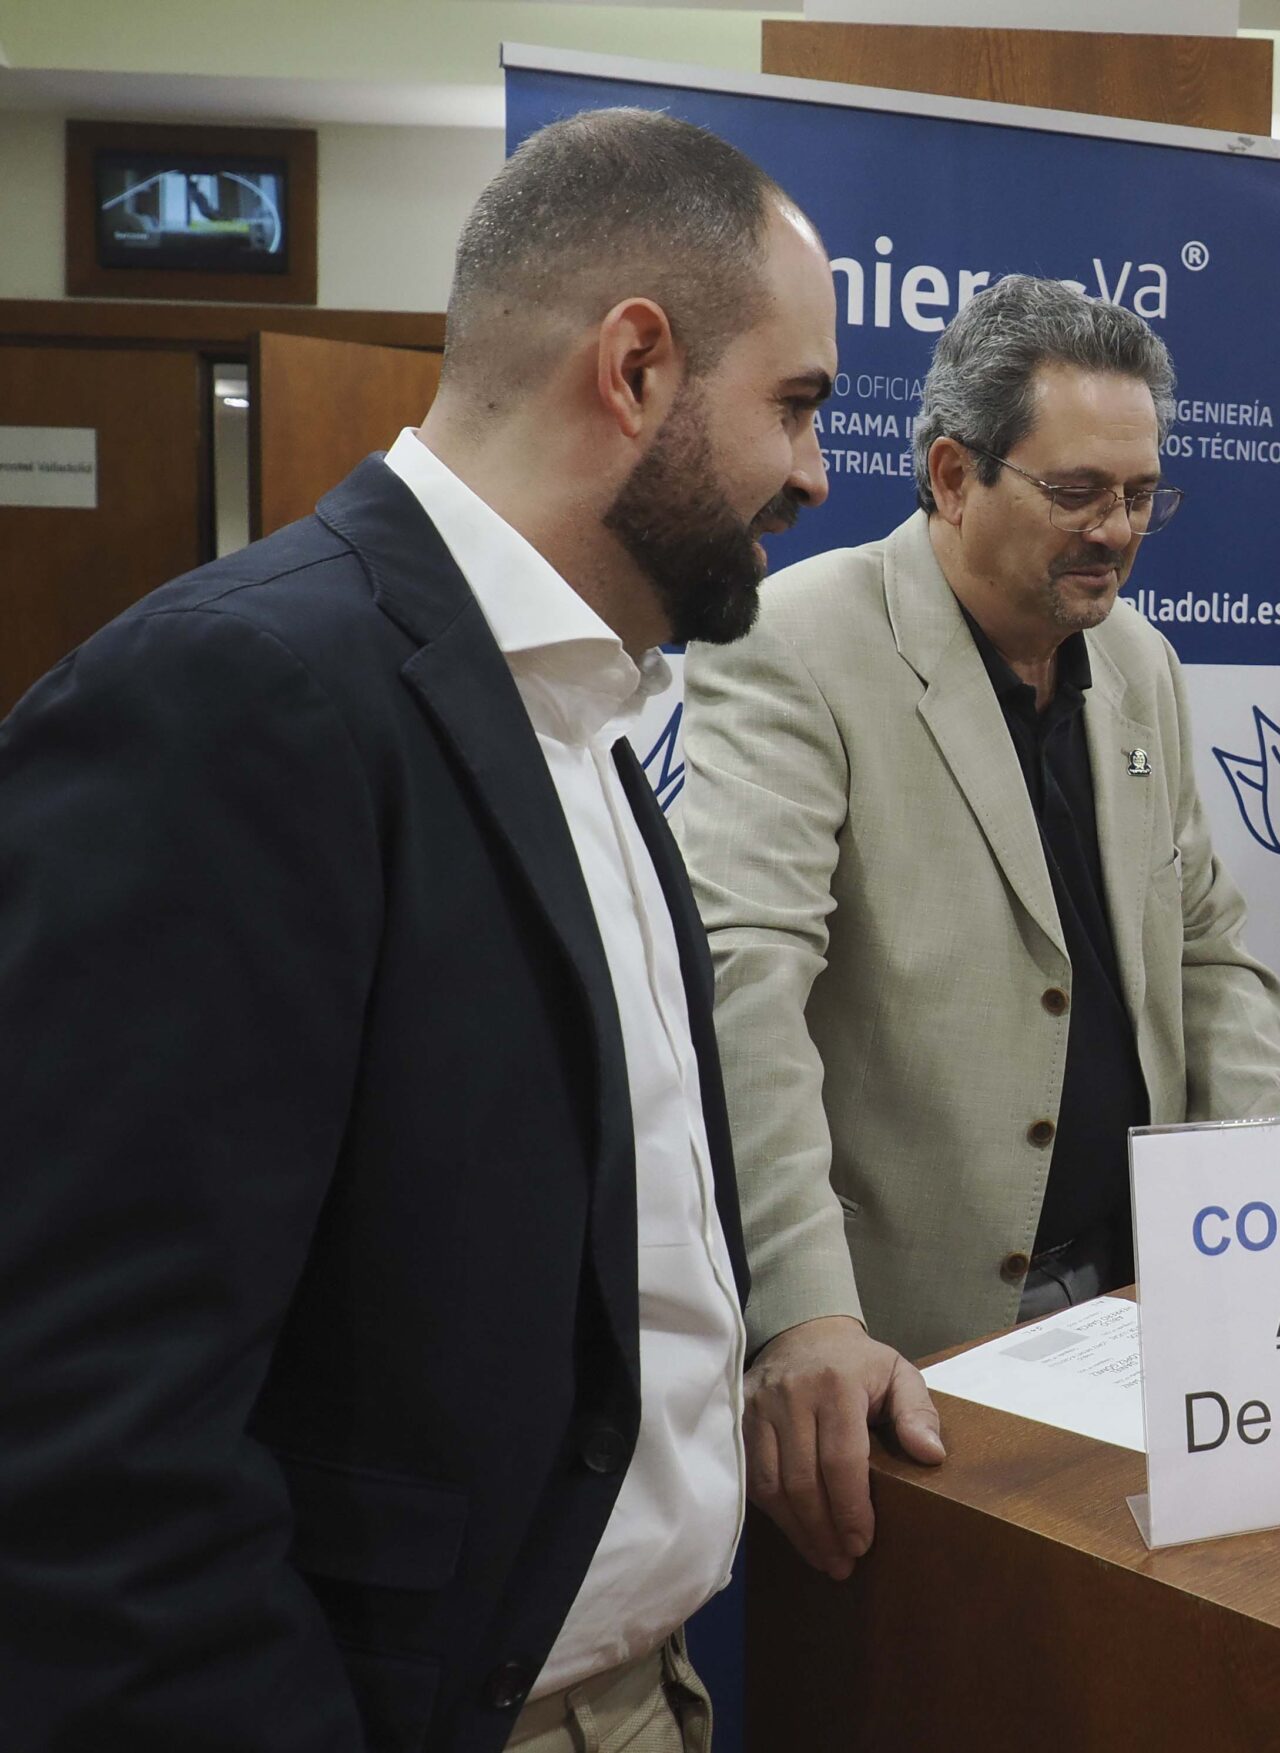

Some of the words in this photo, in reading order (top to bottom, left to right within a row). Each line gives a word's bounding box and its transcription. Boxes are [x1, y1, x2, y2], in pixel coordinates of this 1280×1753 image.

[831, 411, 899, 439] RAMA
[1174, 399, 1273, 427] GENIERÍA
[820, 448, 914, 477] STRIALE
[1185, 1390, 1272, 1453] De
